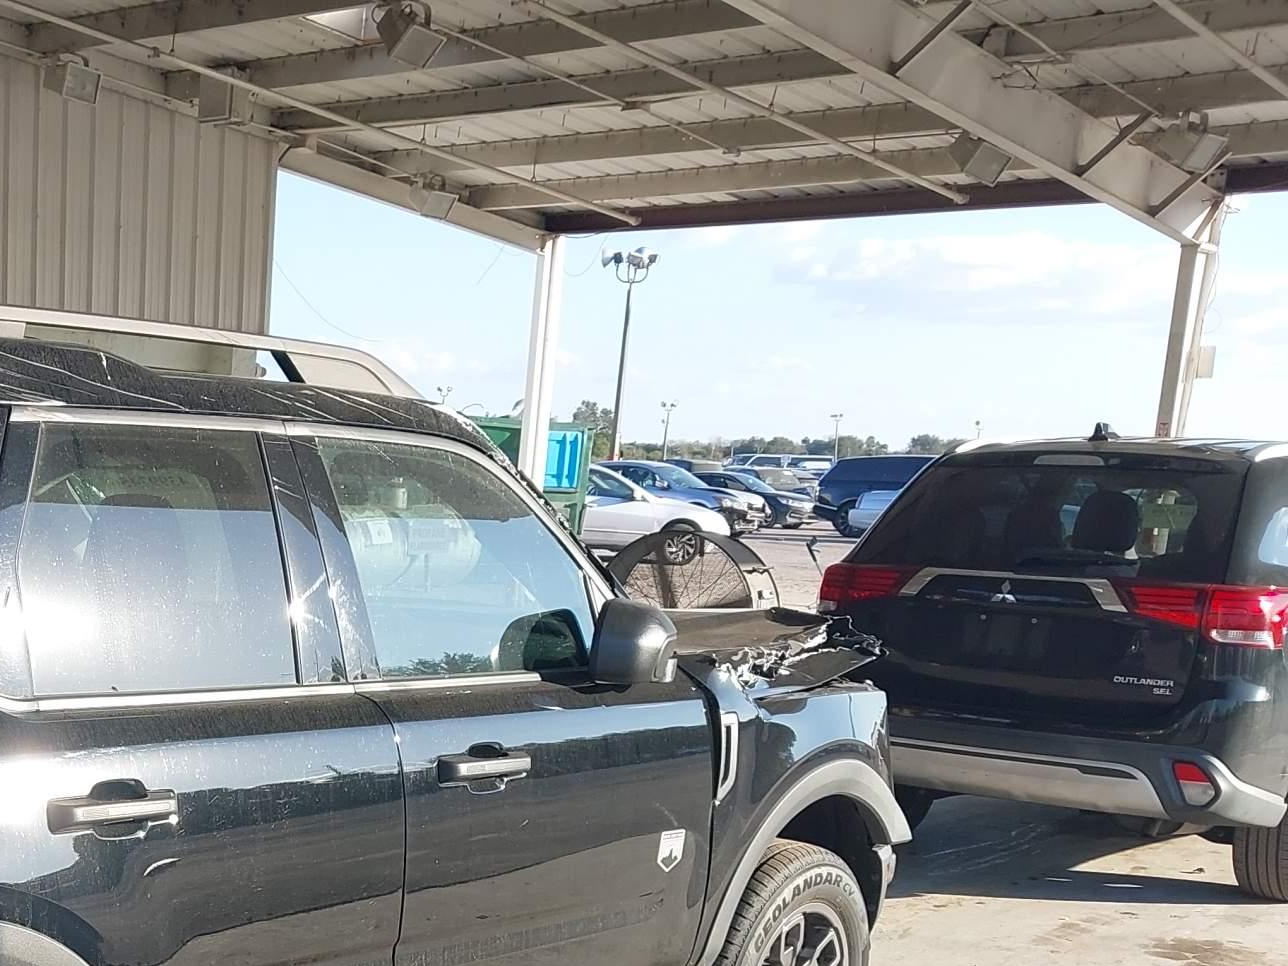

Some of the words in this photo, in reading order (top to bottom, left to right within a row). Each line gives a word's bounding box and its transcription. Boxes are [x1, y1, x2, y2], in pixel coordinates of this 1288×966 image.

[1113, 675, 1174, 687] OUTLANDER
[1152, 687, 1174, 696] SEL
[754, 871, 843, 955] GEOLANDAR
